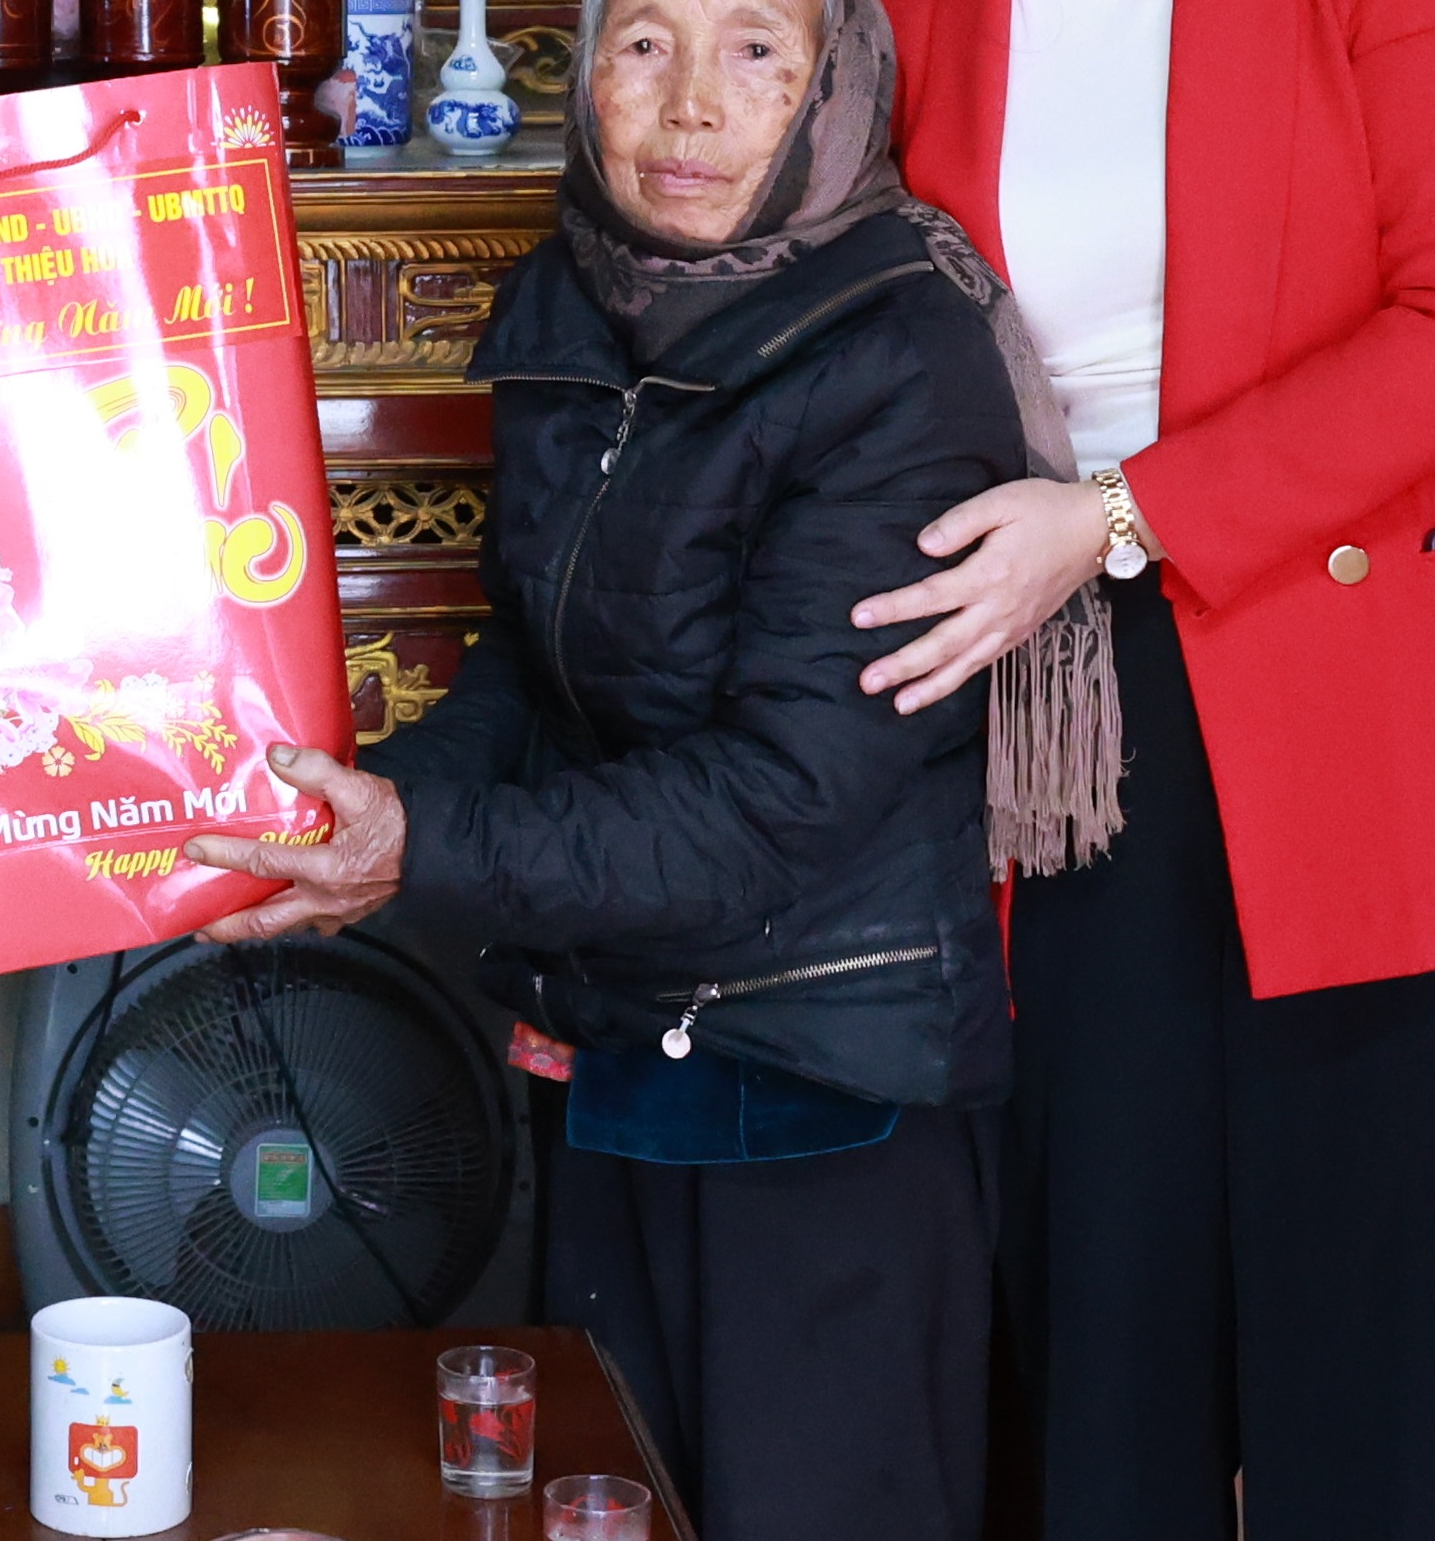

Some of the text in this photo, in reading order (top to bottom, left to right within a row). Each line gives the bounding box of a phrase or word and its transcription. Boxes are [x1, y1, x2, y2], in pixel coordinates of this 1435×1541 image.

[146, 184, 246, 223] UBMTTQ
[0, 245, 75, 286] THIỆU
[89, 795, 175, 831] Năm
[182, 781, 248, 820] Mới
[84, 847, 179, 881] Happy
